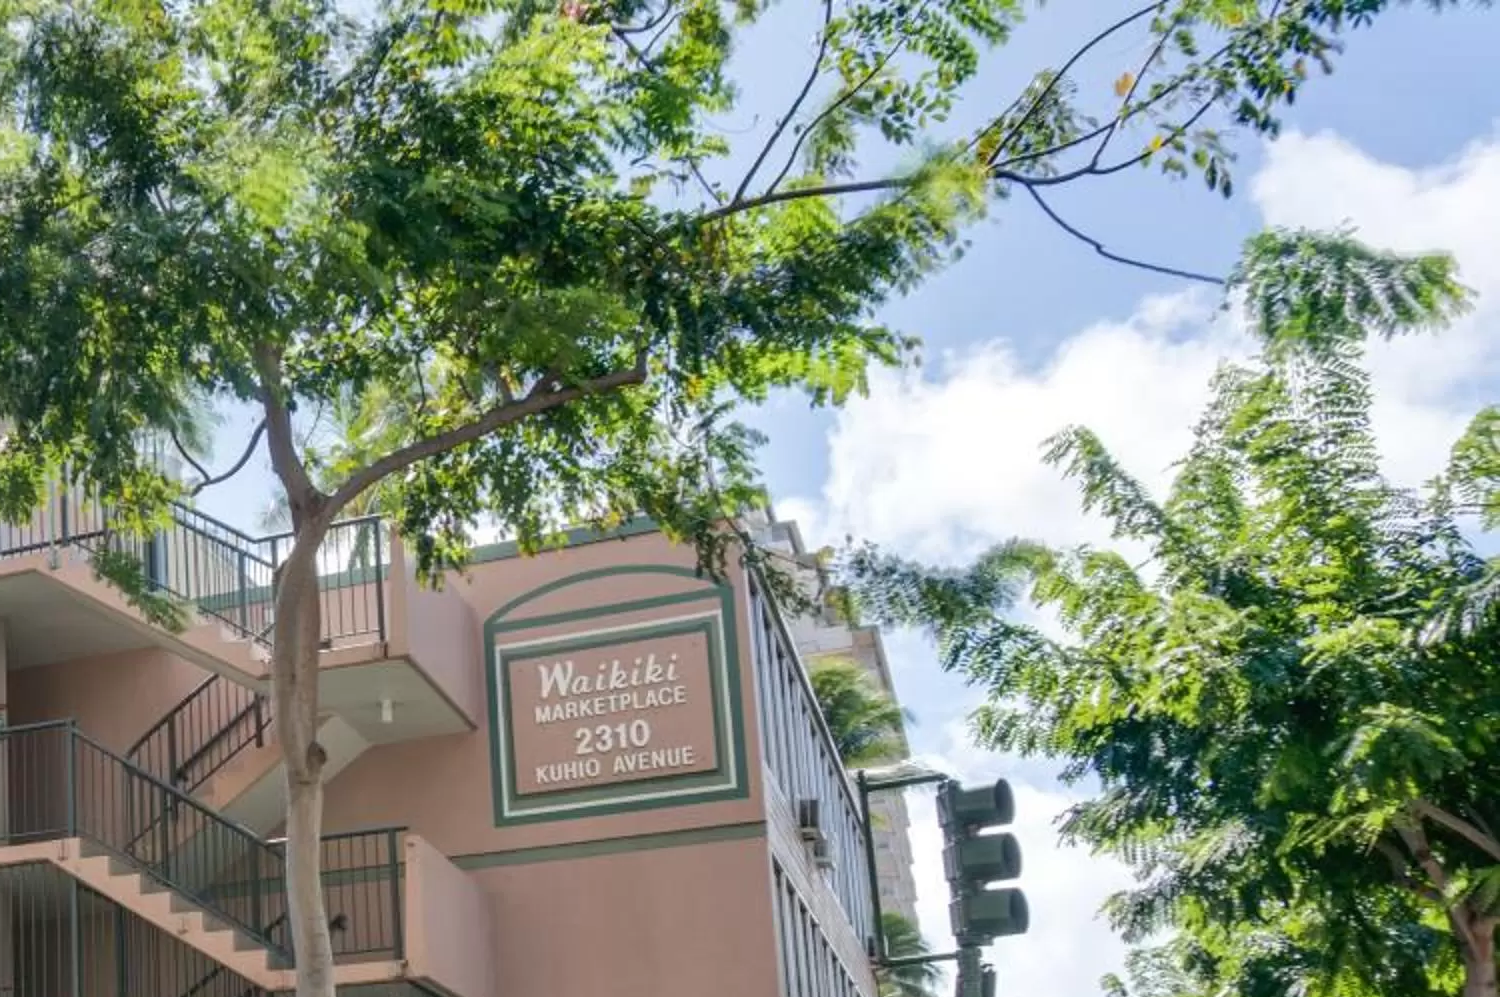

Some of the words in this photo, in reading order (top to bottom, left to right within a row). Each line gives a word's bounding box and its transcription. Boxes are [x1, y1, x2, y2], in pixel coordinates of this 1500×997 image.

[538, 653, 680, 699] Waikiki
[534, 685, 688, 724] MARKETPLACE
[574, 719, 651, 755] 2310
[535, 758, 601, 784] KUHIO
[612, 746, 696, 774] AVENUE
